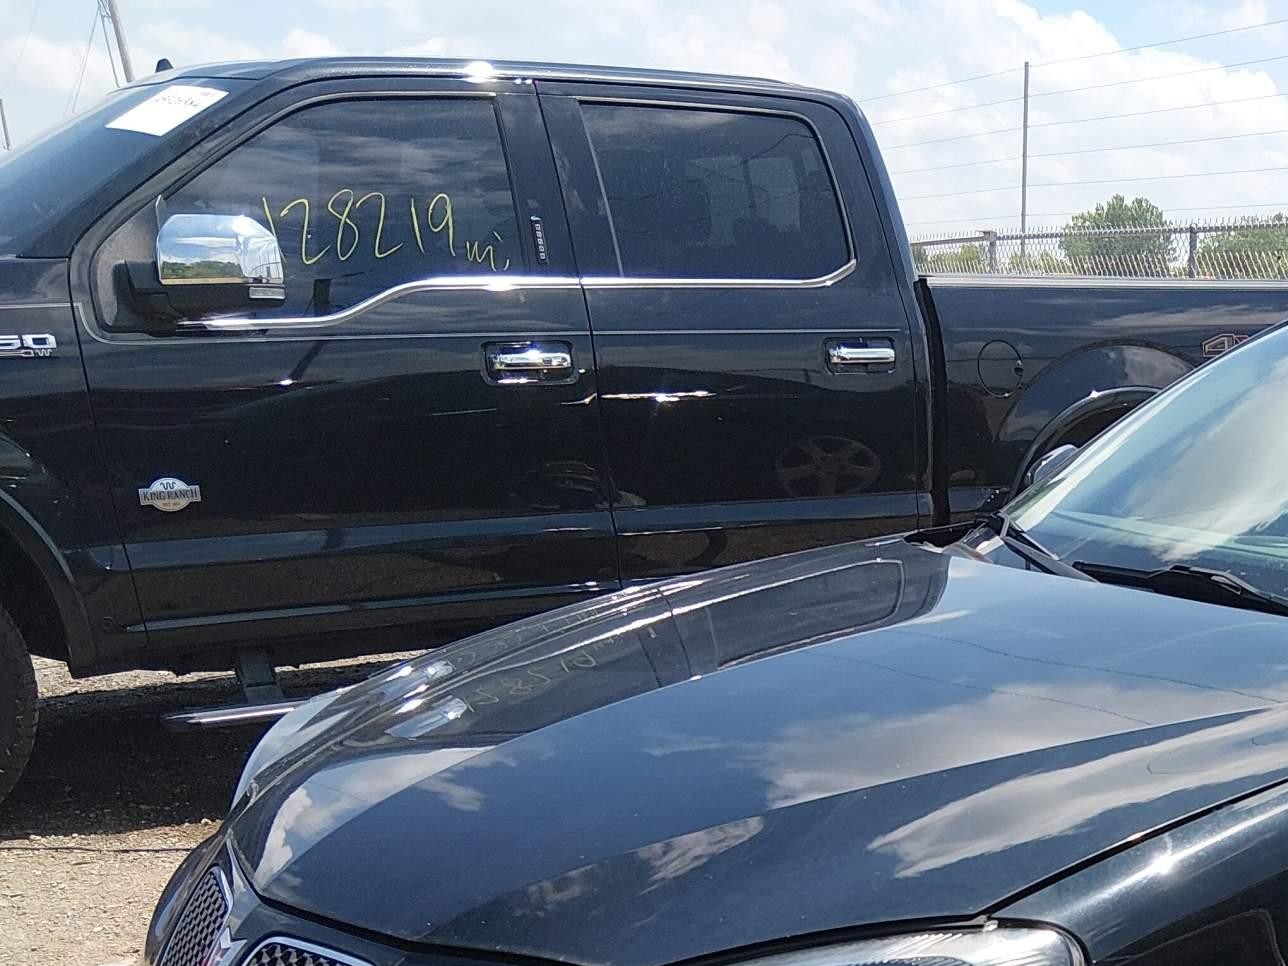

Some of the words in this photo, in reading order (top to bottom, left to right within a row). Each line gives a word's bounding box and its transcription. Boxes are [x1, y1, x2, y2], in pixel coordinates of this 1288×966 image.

[261, 187, 456, 266] 128219
[143, 490, 166, 501] KING
[167, 488, 198, 500] RANCH
